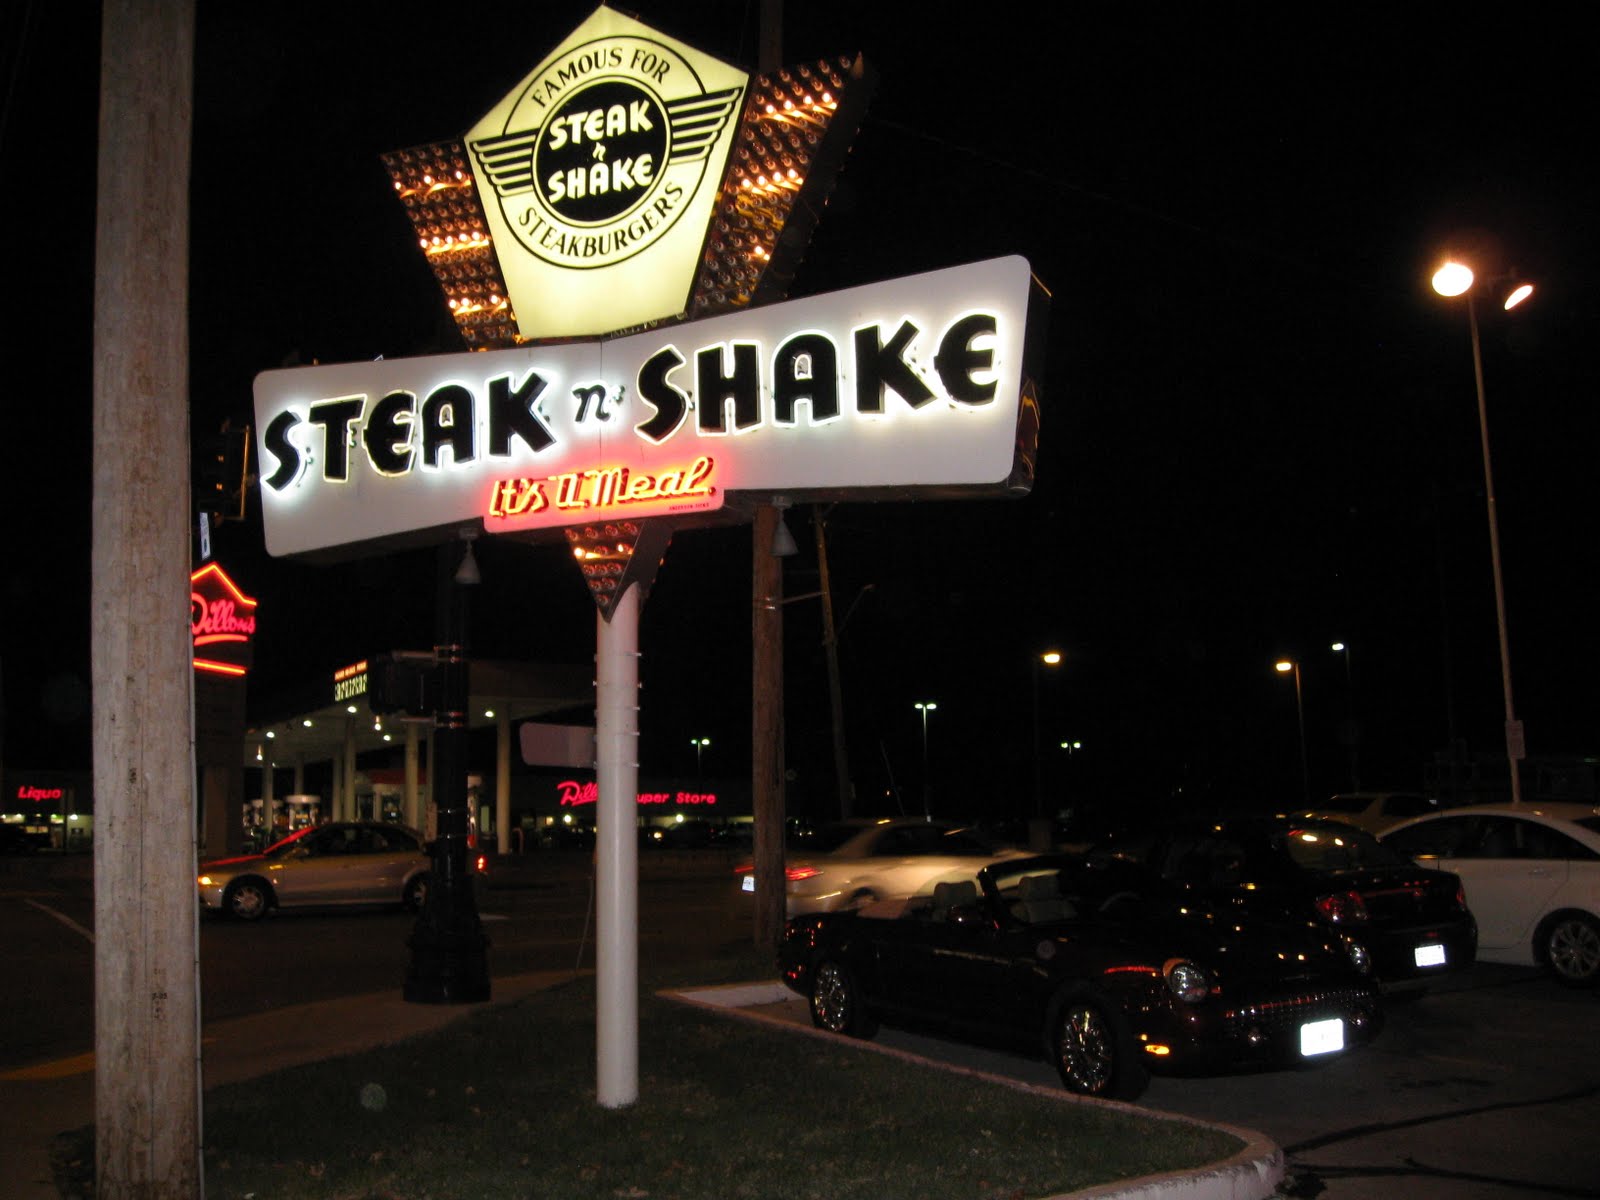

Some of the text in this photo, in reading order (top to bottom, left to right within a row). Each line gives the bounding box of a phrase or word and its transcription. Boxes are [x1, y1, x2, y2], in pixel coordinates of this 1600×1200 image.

[532, 47, 671, 108] FAMOUS FOR
[549, 99, 654, 150] STEAK
[548, 154, 654, 204] SHAKE
[518, 181, 683, 258] STEAKBURGERS
[260, 368, 558, 494] STEAK
[634, 309, 1000, 445] SHAKE
[489, 477, 549, 518] It's
[636, 792, 670, 805] uper
[676, 791, 717, 804] Store
